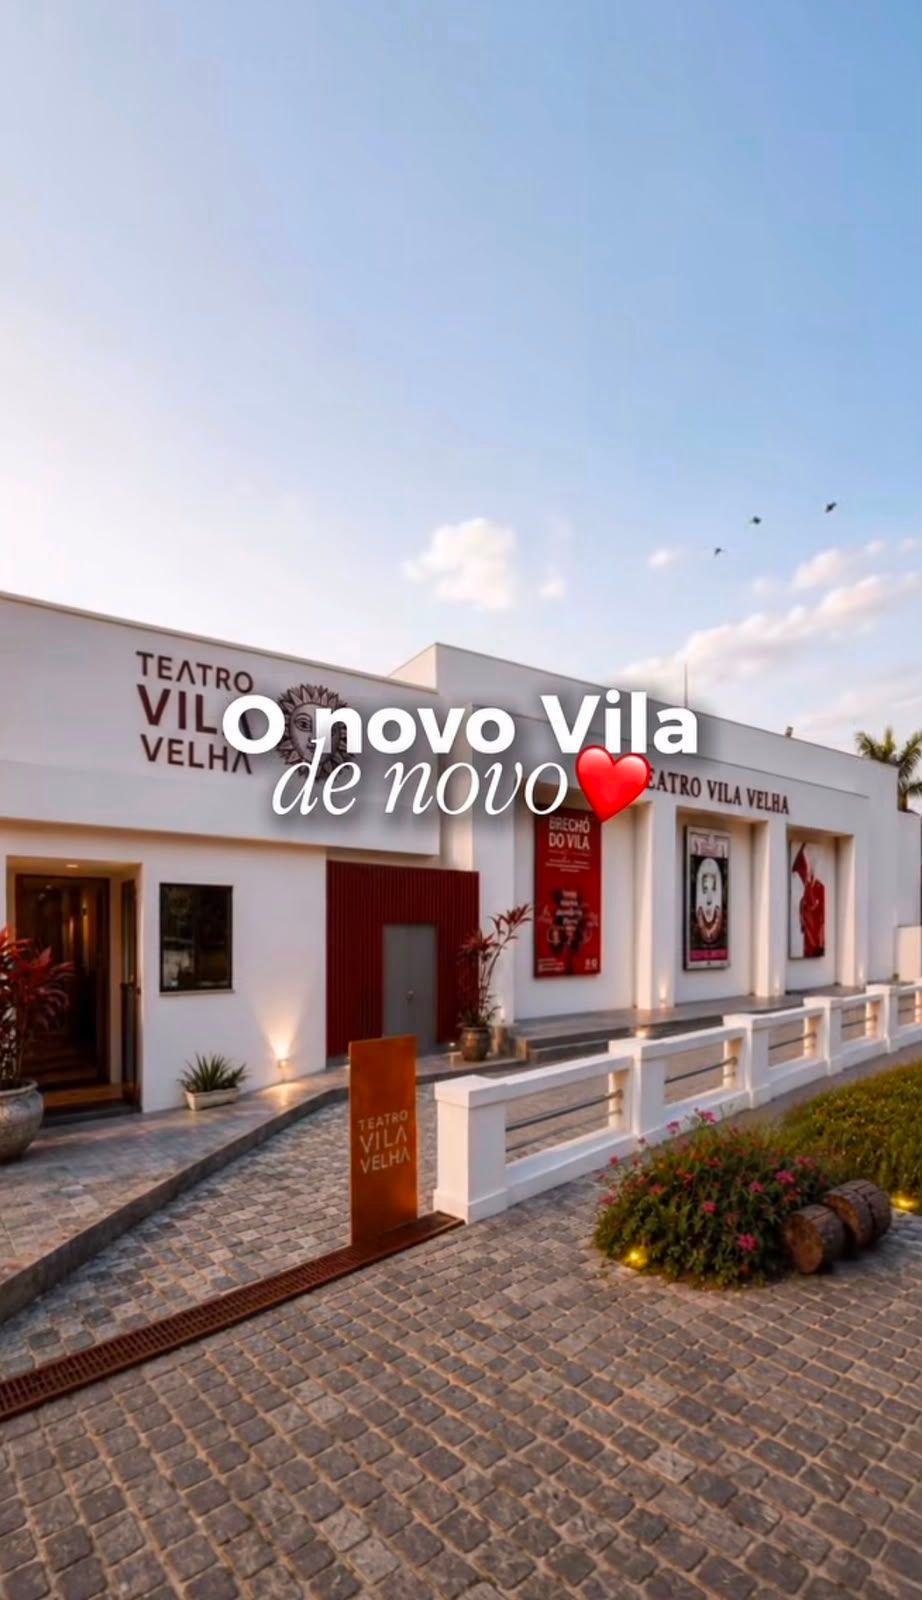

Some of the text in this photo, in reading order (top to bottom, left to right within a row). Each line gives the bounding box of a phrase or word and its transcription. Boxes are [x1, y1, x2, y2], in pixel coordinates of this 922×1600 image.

[136, 651, 254, 694] TEATRO
[136, 684, 253, 741] VIL
[140, 734, 253, 775] VELHA
[707, 780, 742, 806] VILA
[747, 788, 789, 815] VELHA
[548, 832, 591, 850] DO VILA
[358, 1109, 408, 1131] TEATRO
[359, 1124, 408, 1154] VILA
[360, 1145, 411, 1174] VELHA
